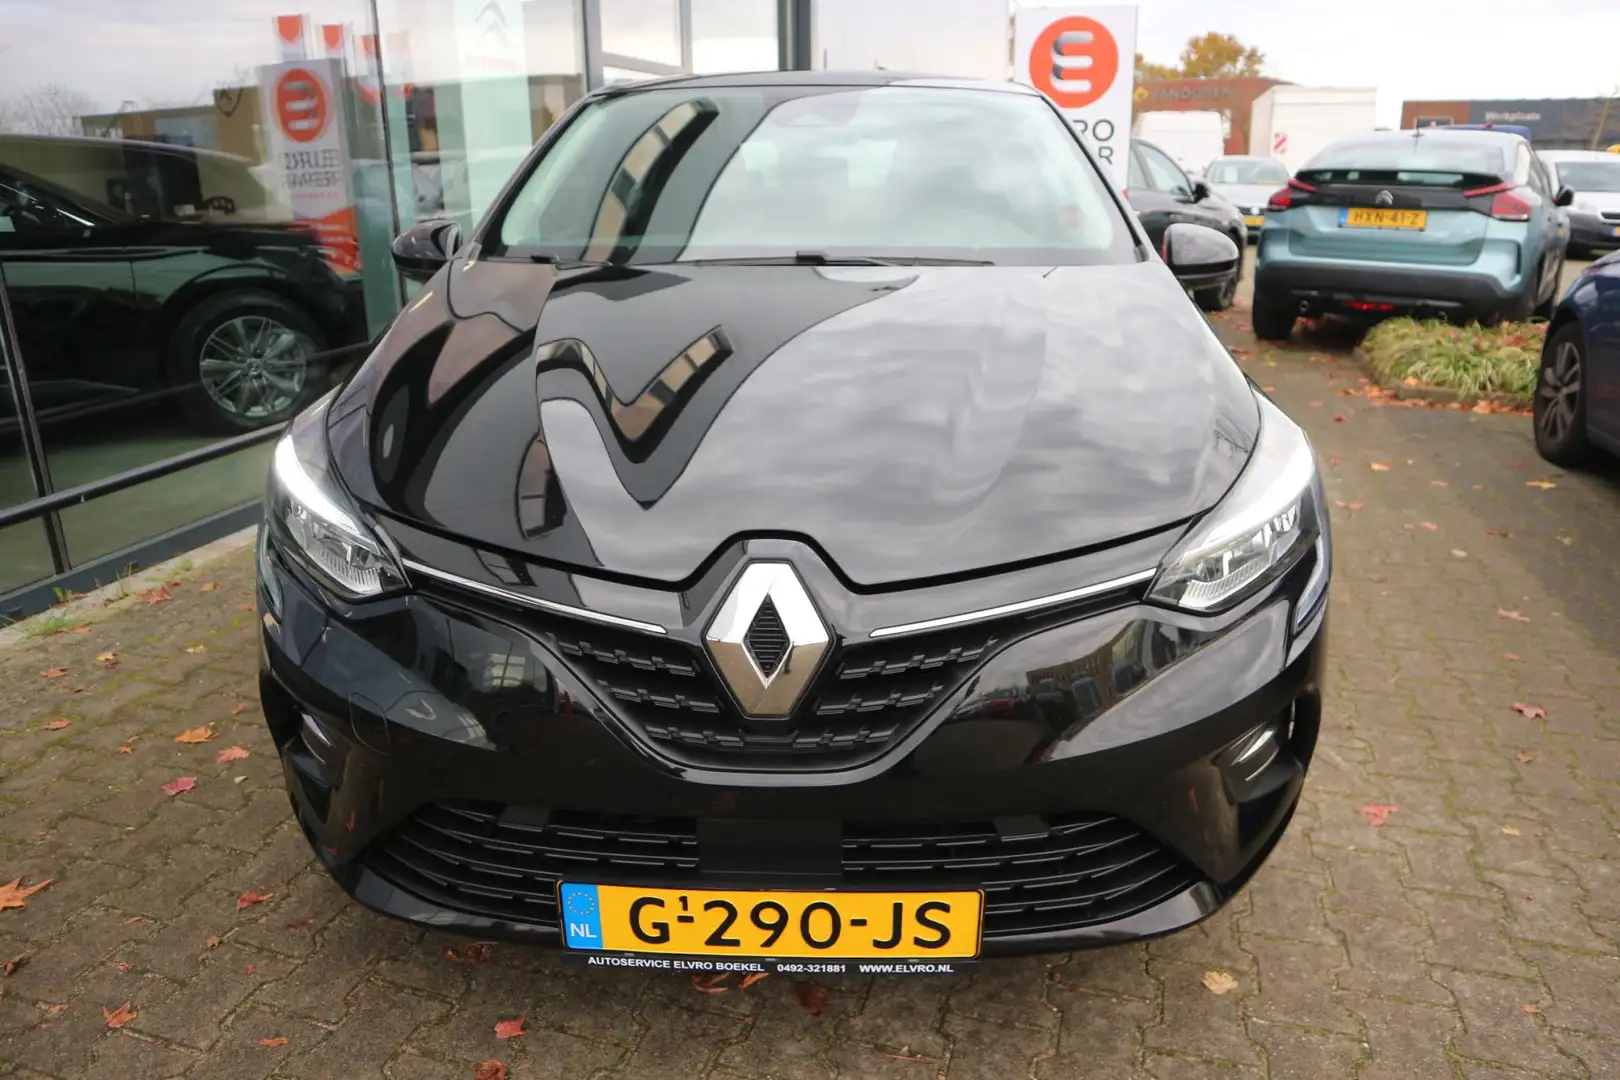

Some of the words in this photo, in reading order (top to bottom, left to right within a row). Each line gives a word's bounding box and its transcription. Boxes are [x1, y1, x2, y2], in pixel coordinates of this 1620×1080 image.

[1073, 119, 1115, 142] RO
[570, 923, 597, 938] NL
[588, 956, 671, 969] AUTOSERVICE
[673, 961, 713, 970] ELVRO
[715, 962, 765, 972] BOEKEL
[777, 964, 846, 973] 0492-321881
[859, 964, 954, 973] WWW.ELVRO.NL
